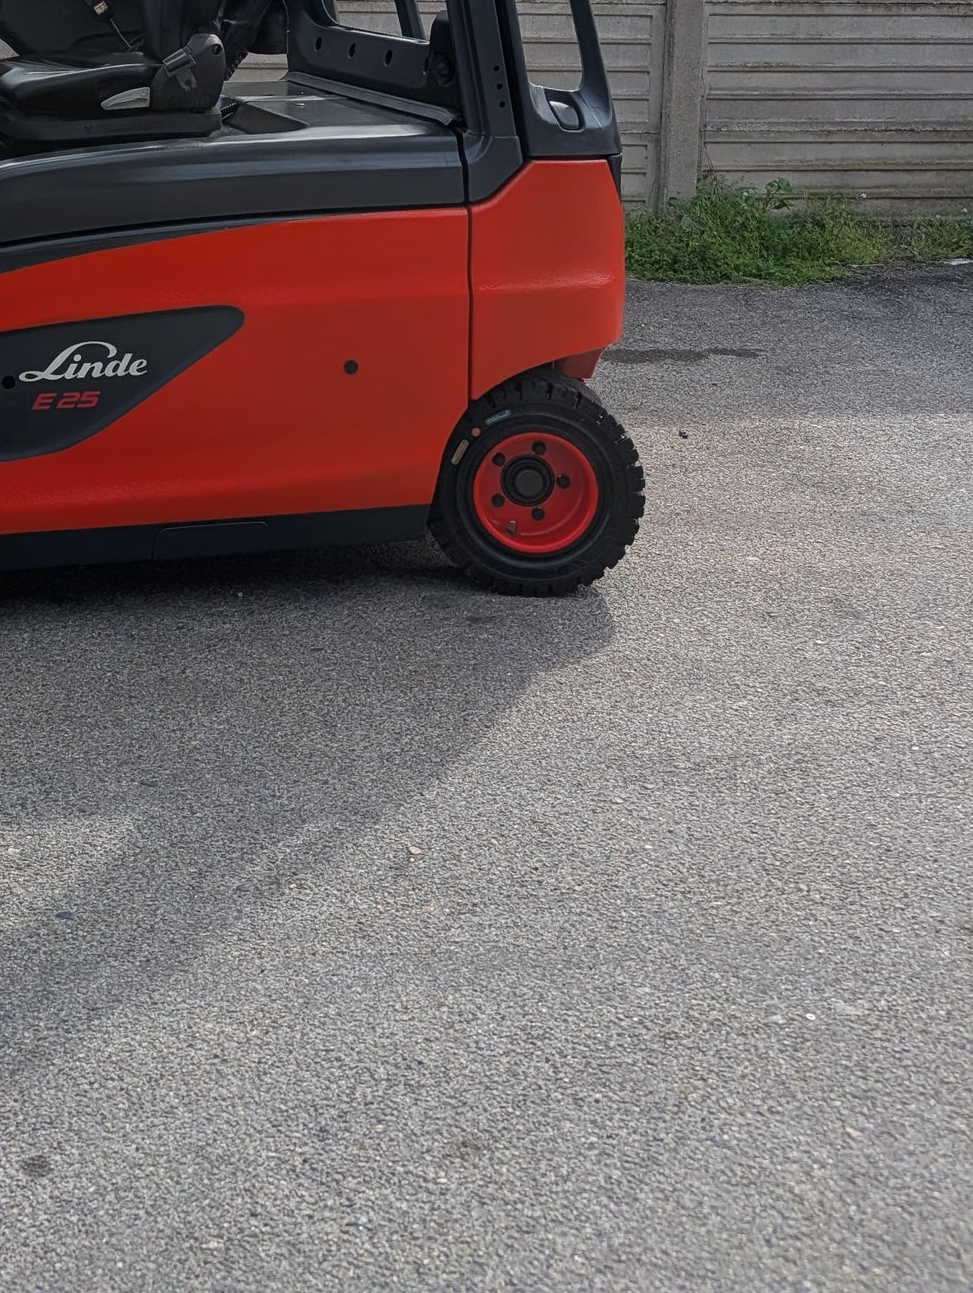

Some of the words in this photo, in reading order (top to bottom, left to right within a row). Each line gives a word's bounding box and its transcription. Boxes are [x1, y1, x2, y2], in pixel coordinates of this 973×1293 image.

[19, 341, 148, 383] Linde
[31, 393, 56, 411] E
[56, 390, 101, 409] 25
